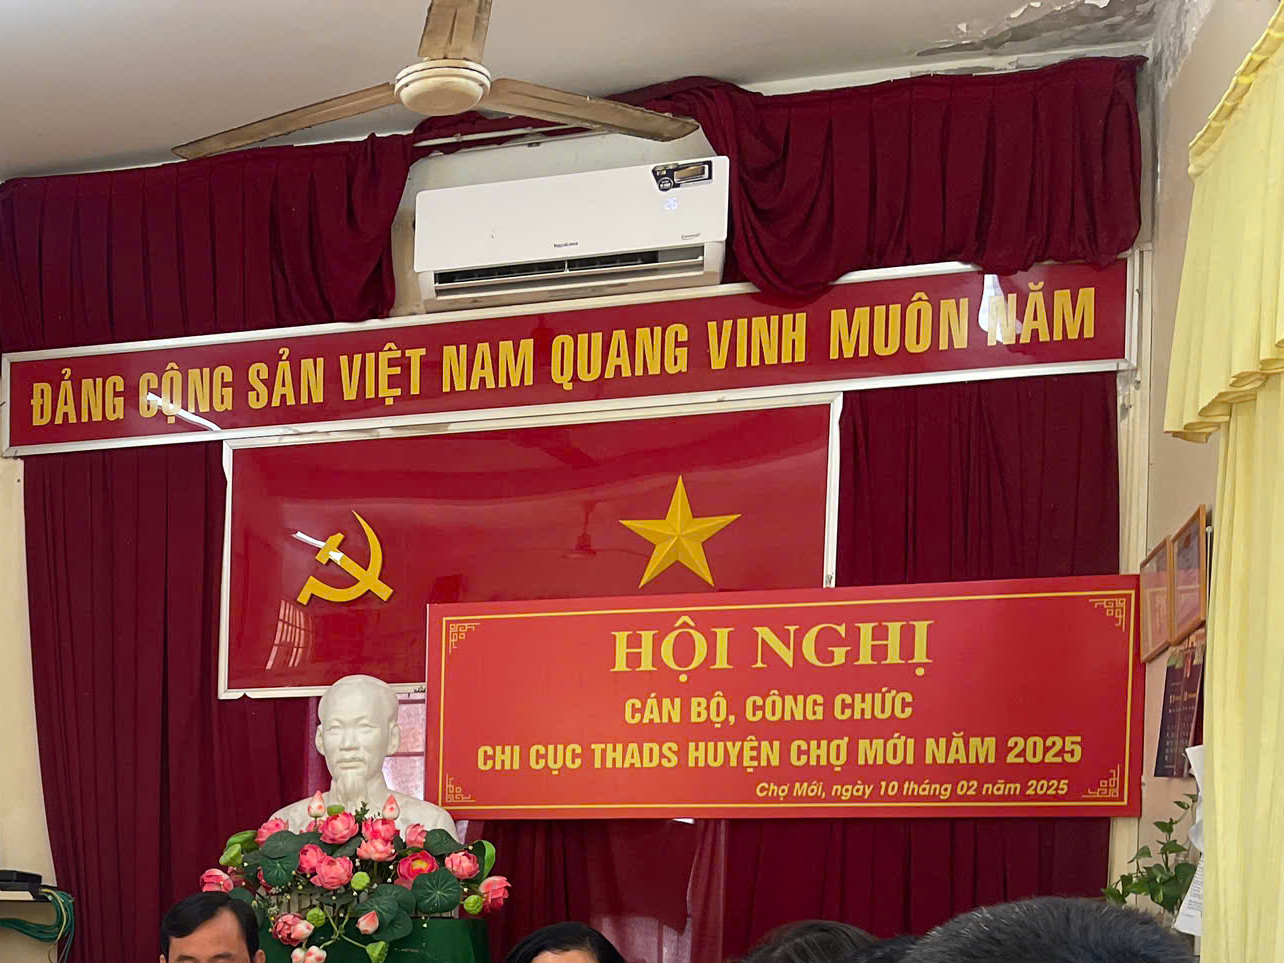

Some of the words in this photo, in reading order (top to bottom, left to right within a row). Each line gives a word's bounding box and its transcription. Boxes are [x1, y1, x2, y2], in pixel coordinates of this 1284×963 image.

[31, 368, 124, 426] ĐẢNG
[139, 363, 233, 423] CỘNG
[248, 348, 324, 408] SẢN
[339, 343, 426, 405] VIỆT
[442, 338, 534, 392] NAM
[551, 323, 688, 390] QUANG
[707, 312, 807, 370] VINH
[829, 292, 968, 360] MUÔN
[987, 281, 1095, 347] NĂM
[609, 615, 735, 682] HỘI
[752, 620, 934, 676] NGHỊ
[624, 693, 681, 724] CÁN
[690, 691, 735, 728] BỘ,
[745, 690, 824, 722] CÔNG
[834, 687, 913, 720] CHỨC
[477, 745, 520, 770] CHI
[529, 744, 582, 775] CỤC
[591, 742, 678, 769] THADS
[688, 736, 780, 772] HUYỆN
[790, 737, 849, 771] CHỢ
[858, 732, 915, 766] MỚI
[925, 732, 996, 764] NĂM
[1006, 735, 1082, 763] 2025
[756, 782, 789, 800] Chợ
[793, 780, 826, 800] Mới,
[831, 781, 873, 799] ngày
[879, 781, 898, 796] 10
[903, 780, 952, 799] tháng
[957, 780, 978, 796] 02
[982, 780, 1021, 795] năm
[1027, 779, 1069, 795] 2025
